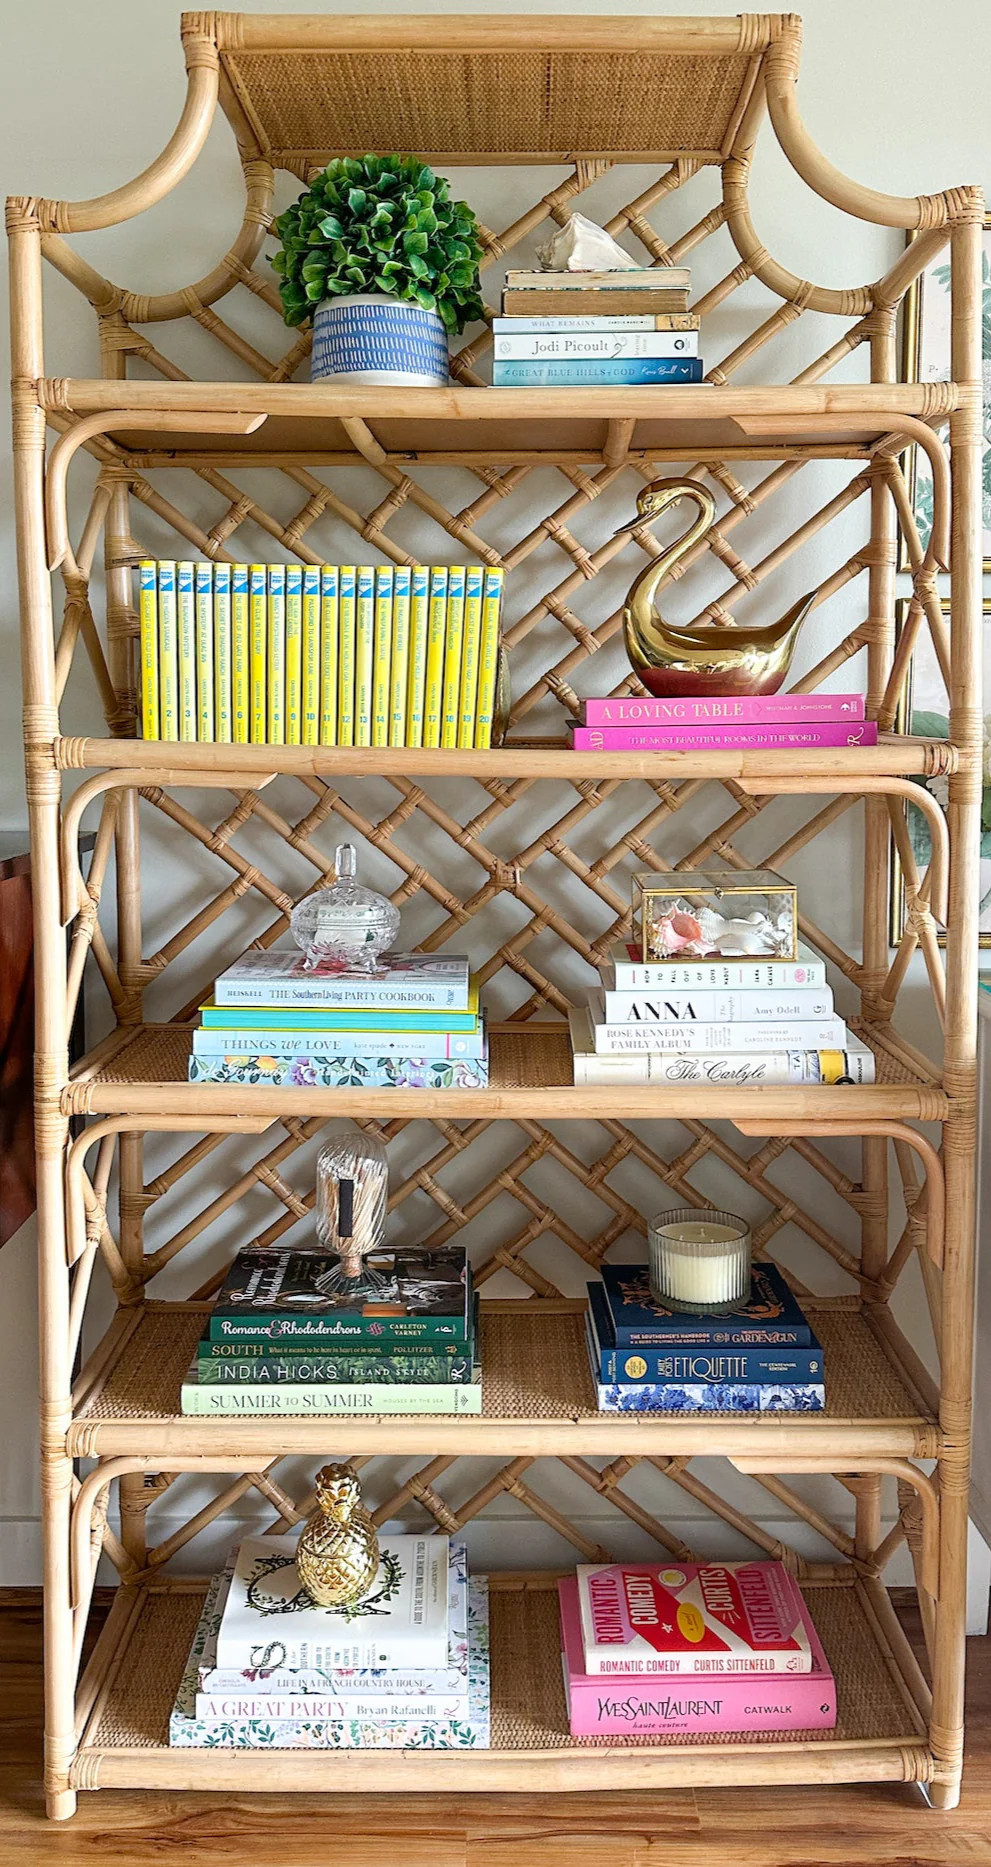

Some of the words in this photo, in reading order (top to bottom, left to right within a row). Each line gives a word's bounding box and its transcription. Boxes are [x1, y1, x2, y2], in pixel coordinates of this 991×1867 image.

[532, 340, 560, 355] Jodi
[565, 340, 608, 352] Picoult
[512, 369, 544, 377] GREAT
[428, 714, 437, 723] 17
[463, 714, 472, 722] 19
[601, 707, 612, 720] A
[620, 704, 686, 719] LOVING
[692, 703, 744, 717] TABLE
[377, 715, 385, 723] 14
[446, 715, 454, 723] 18
[479, 715, 490, 723] 20
[590, 732, 604, 750] AD
[658, 973, 662, 981] TO
[697, 972, 702, 981] OF
[269, 990, 290, 999] THE
[292, 989, 323, 999] Southern
[323, 990, 343, 1000] Living
[344, 991, 377, 1000] PARTY
[378, 992, 435, 1001] COOKBOOK
[627, 1002, 697, 1020] ANNA
[754, 1007, 773, 1016] Amy
[607, 1029, 632, 1037] ROSE
[635, 1028, 695, 1037] KENNEDY'S
[221, 1039, 277, 1050] THINGS
[281, 1040, 302, 1050] we
[306, 1040, 342, 1050] LOVE
[611, 1040, 650, 1049] FAMILY
[654, 1040, 691, 1048] ALBUM
[665, 1059, 700, 1080] The
[703, 1060, 766, 1085] Carlyle
[230, 1269, 263, 1302] Romance
[221, 1321, 270, 1335] Romance
[281, 1321, 362, 1335] Rhododendrons
[212, 1345, 264, 1356] SOUTH
[218, 1365, 270, 1379] INDIA
[274, 1365, 337, 1379] HICKS
[451, 1361, 467, 1380] R
[674, 1357, 748, 1382] ETIQUETTE
[210, 1395, 281, 1408] SUMMER
[285, 1397, 298, 1406] TO
[302, 1394, 373, 1408] SUMMER
[700, 1569, 735, 1611] CURTIS
[624, 1575, 659, 1625] COMEDY
[737, 1570, 782, 1640] SITTENFELD
[590, 1579, 624, 1643] ROMANTIC
[600, 1660, 644, 1672] ROMANTIC
[646, 1660, 680, 1672] COMEDY
[694, 1659, 724, 1671] CURTIS
[727, 1659, 775, 1671] SITTENFELD
[205, 1702, 218, 1716] A
[221, 1701, 286, 1716] GREAT
[290, 1701, 348, 1717] PARTY
[356, 1704, 388, 1718] Bryan
[390, 1704, 436, 1715] Rafanelli
[744, 1706, 792, 1714] CATWALK
